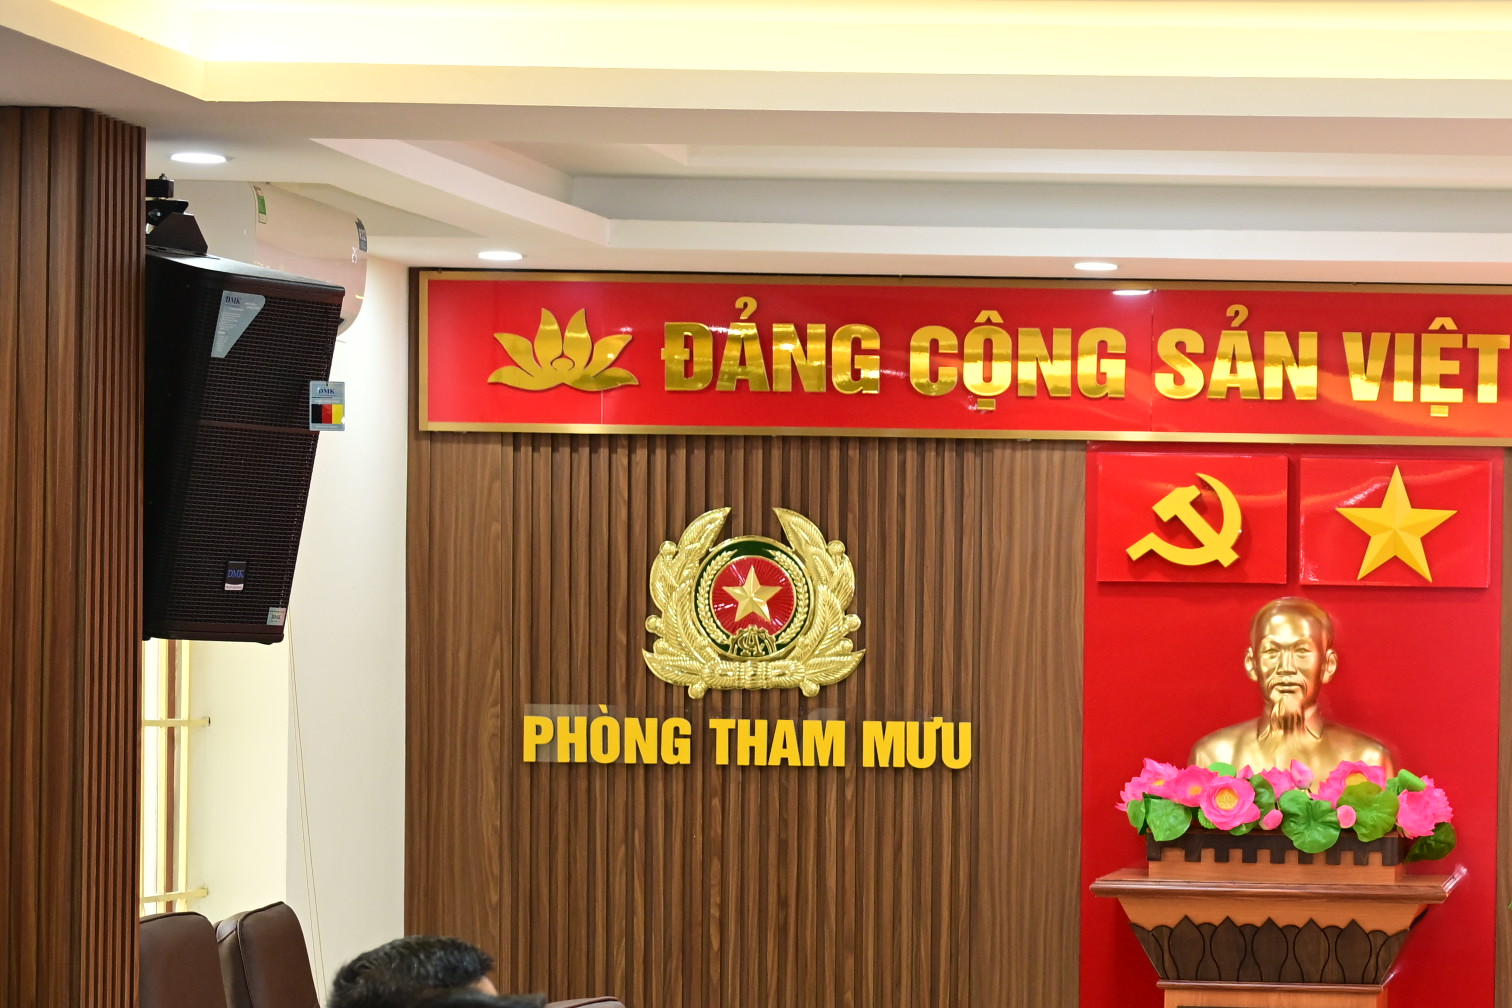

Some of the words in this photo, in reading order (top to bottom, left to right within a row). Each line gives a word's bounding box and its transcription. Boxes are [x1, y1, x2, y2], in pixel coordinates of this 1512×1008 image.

[661, 296, 881, 394] ĐẢNG
[909, 310, 1126, 410] CỘNG
[1154, 304, 1318, 400] SẢN
[1342, 317, 1510, 417] VIỆT
[522, 704, 691, 764] PHÒNG
[709, 719, 845, 767] THAM
[862, 717, 972, 770] MƯU
